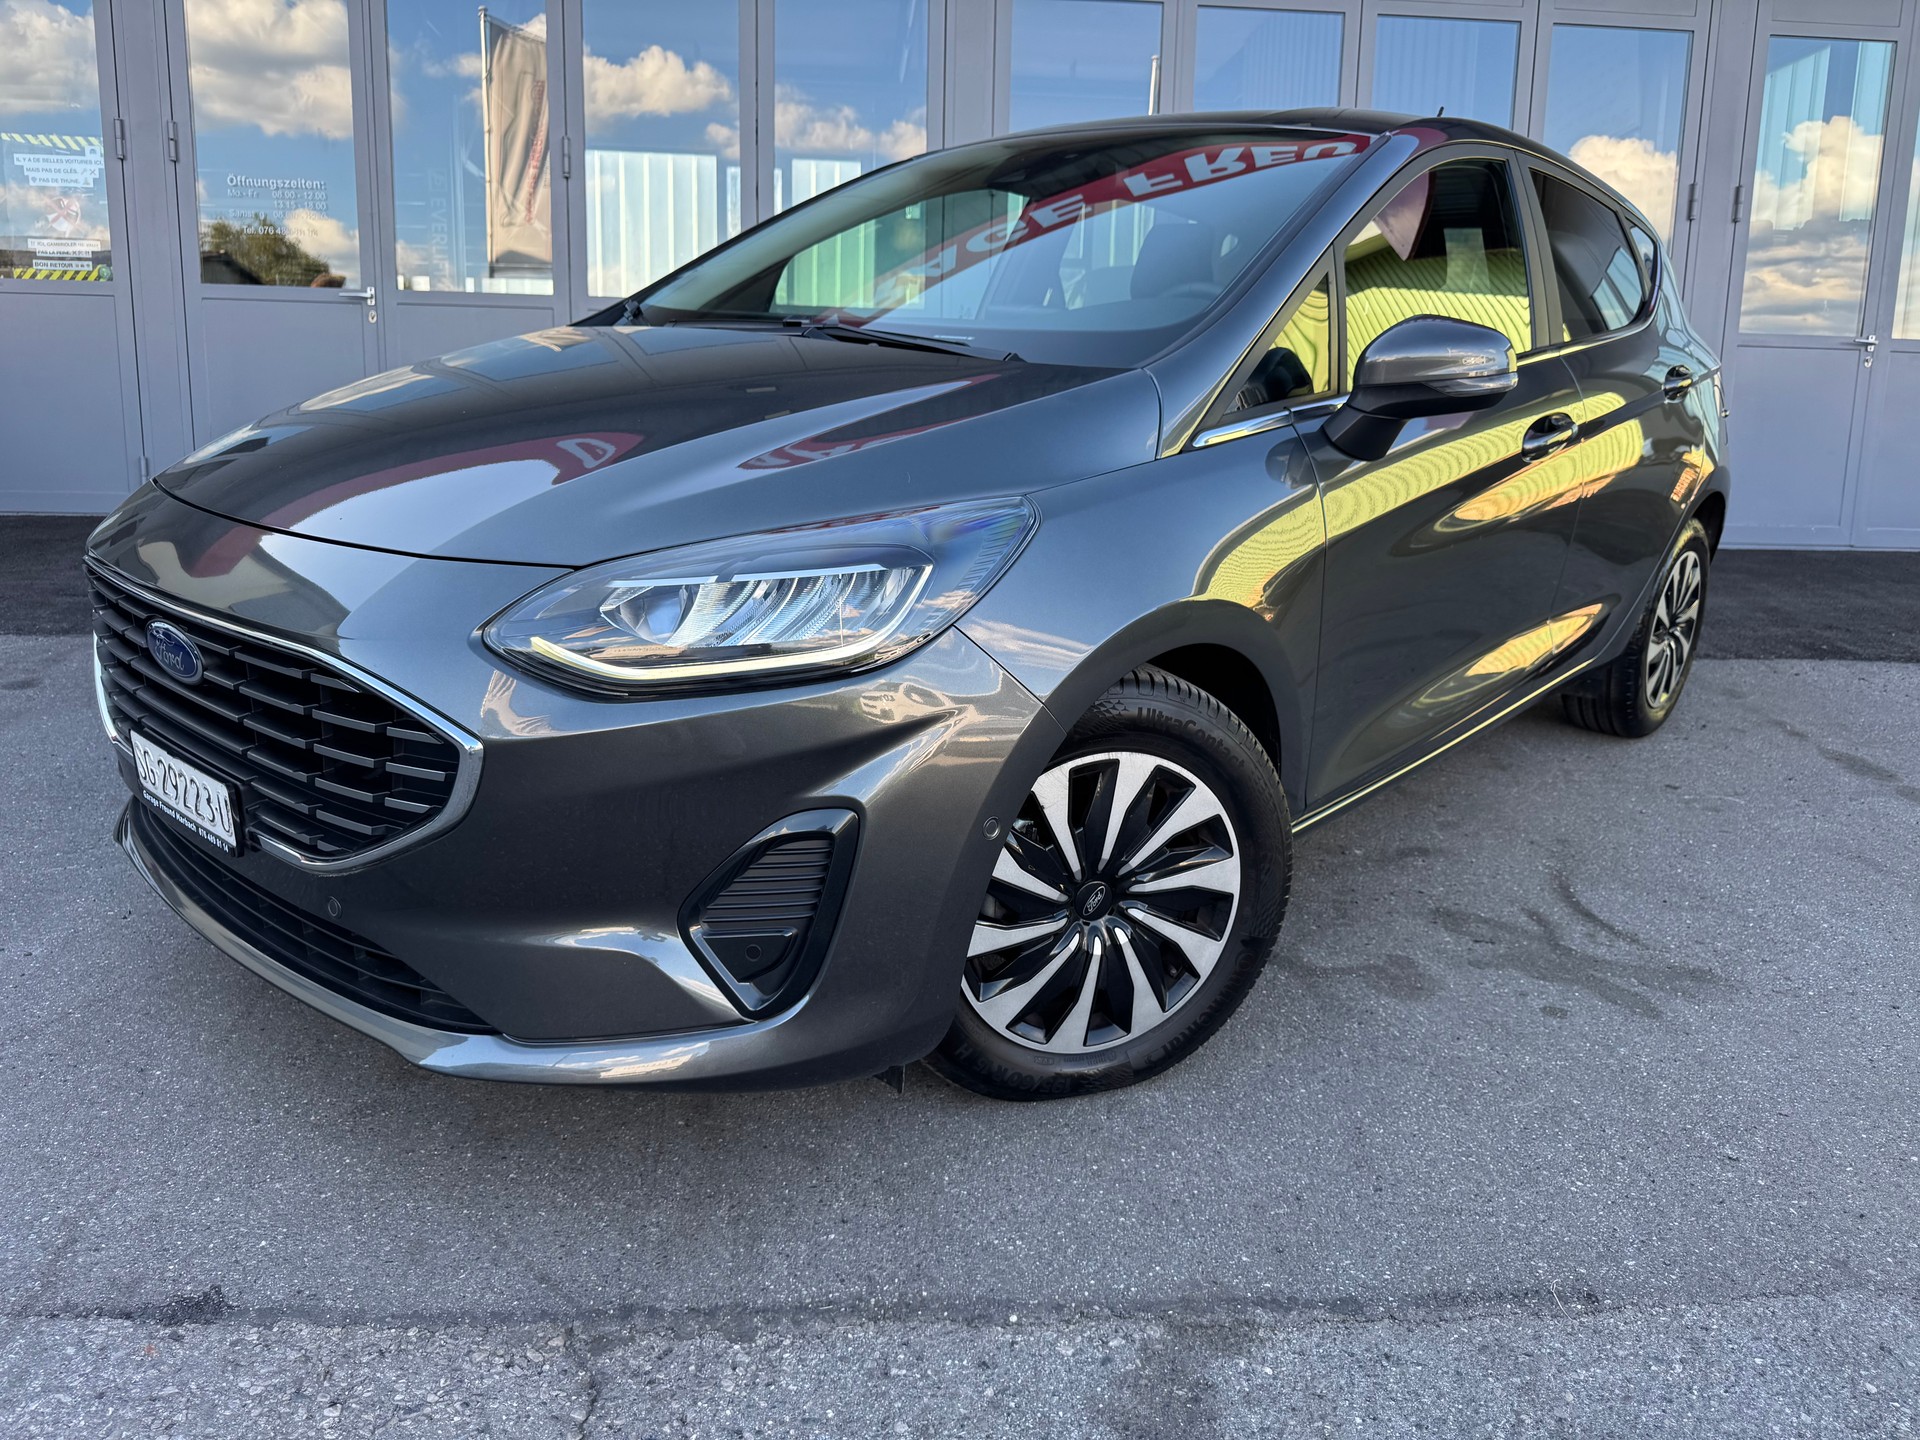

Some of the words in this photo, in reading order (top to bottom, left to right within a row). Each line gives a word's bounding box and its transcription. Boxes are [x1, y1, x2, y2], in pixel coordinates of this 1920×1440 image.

[42, 157, 65, 165] BELLES
[25, 166, 41, 174] MAIS
[226, 173, 327, 191] Öffnungszeiten:
[258, 225, 275, 236] 076
[34, 260, 49, 268] BON
[49, 261, 74, 269] RETOUR
[142, 789, 159, 807] Garage
[159, 800, 176, 818] Freund
[175, 811, 197, 833] Marbach
